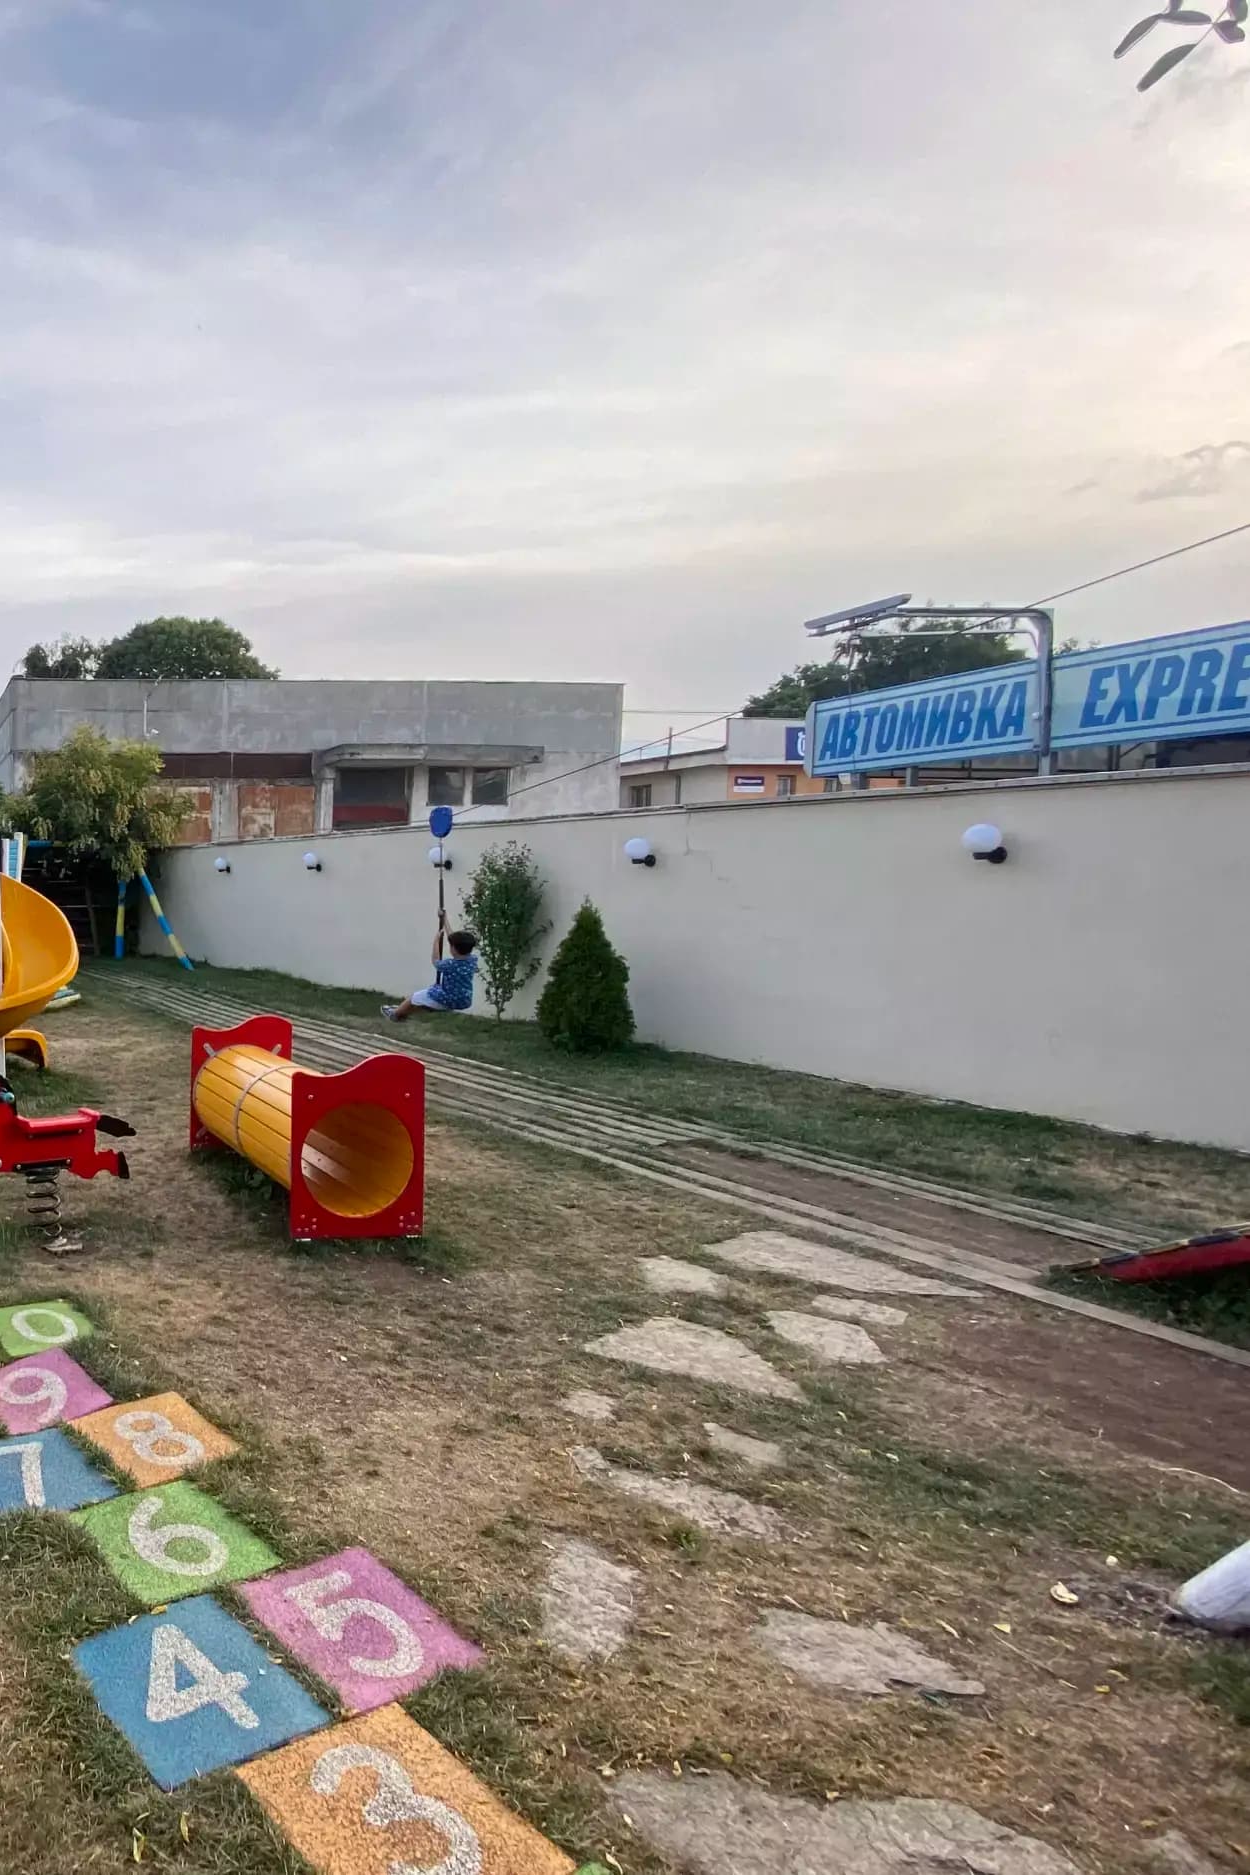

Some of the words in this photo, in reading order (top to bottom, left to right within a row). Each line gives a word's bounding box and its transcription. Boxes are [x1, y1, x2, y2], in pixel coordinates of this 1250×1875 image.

[819, 680, 1028, 760] АВТОМИВКА
[1079, 643, 1250, 728] EXPRE
[114, 1410, 206, 1467] 8
[128, 1497, 229, 1577] 6
[145, 1623, 261, 1729] 4
[282, 1570, 425, 1679] 5
[310, 1743, 483, 1875] 3
